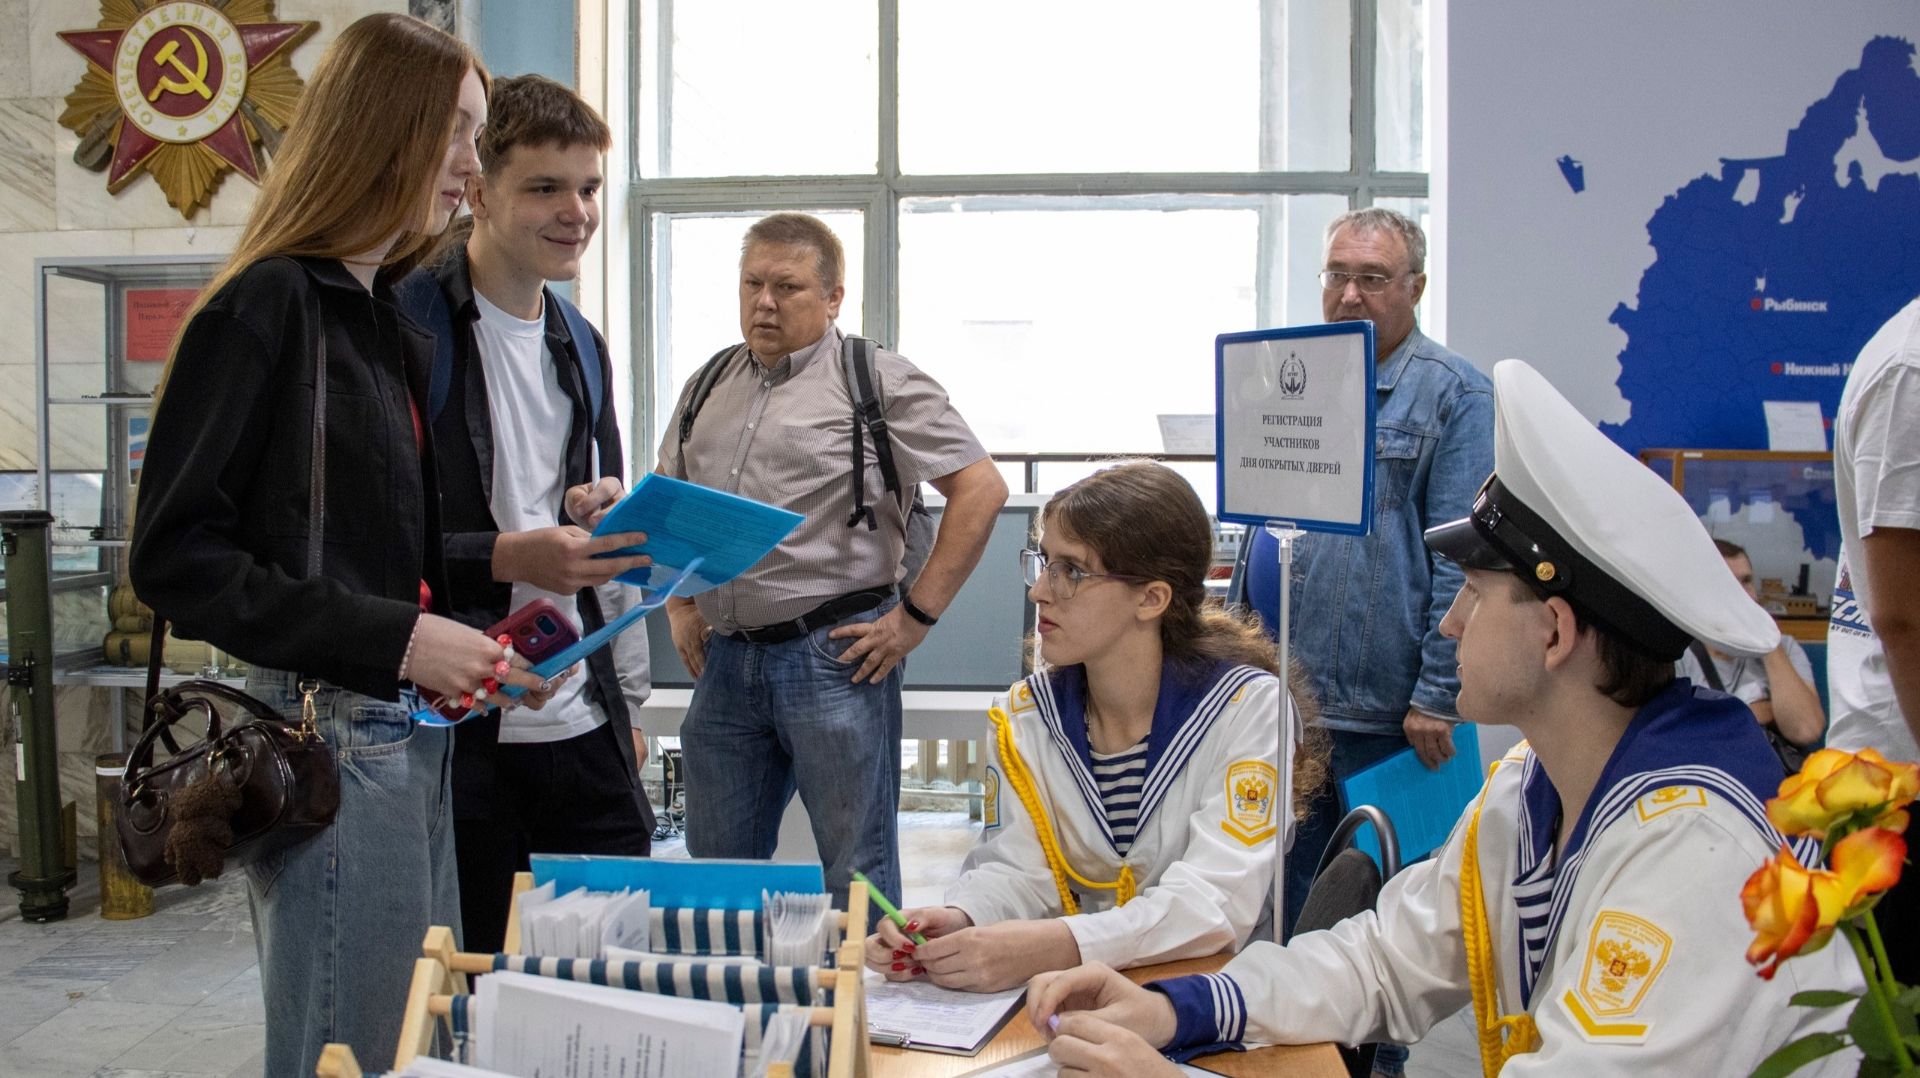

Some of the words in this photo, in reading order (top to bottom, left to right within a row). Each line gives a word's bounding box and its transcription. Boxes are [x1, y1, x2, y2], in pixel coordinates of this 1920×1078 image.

[120, 5, 231, 125] ОТЕЧЕСТВЕННАЯ
[207, 53, 241, 123] ВОЙНА
[1764, 297, 1828, 311] Рыбинск
[1784, 362, 1841, 376] Нижний
[1262, 414, 1323, 428] РЕГИСТРАЦИЯ
[1264, 436, 1320, 450] УЧАСТНИКОВ
[1239, 456, 1257, 469] ДНЯ
[1258, 458, 1305, 472] ОТКРЫТЫХ
[1306, 461, 1341, 475] ДВЕРЕЙ
